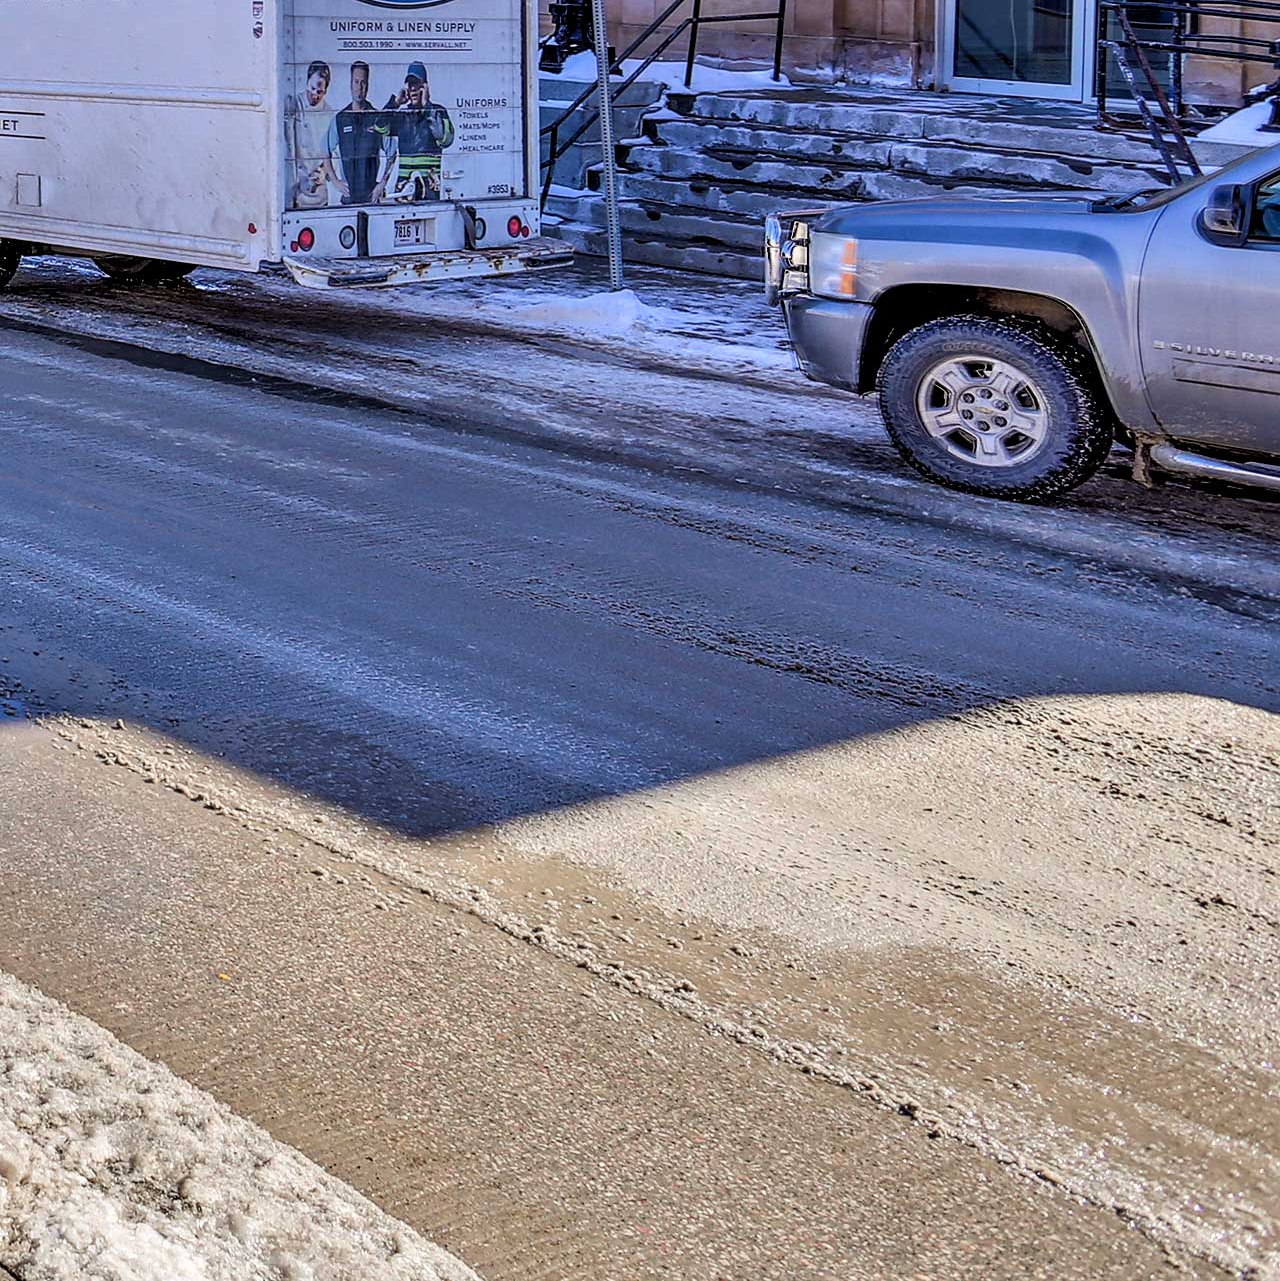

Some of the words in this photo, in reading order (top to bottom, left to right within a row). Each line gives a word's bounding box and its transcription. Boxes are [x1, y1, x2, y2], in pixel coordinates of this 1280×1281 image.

[330, 21, 383, 32] UNIFORM
[386, 22, 394, 32] &
[398, 22, 432, 32] LINEN
[435, 23, 476, 32] SUPPLY
[343, 41, 394, 49] 800.503.1990
[456, 98, 507, 108] UNIFORMS
[487, 184, 509, 194] #3953
[1171, 342, 1280, 365] SILVERA
